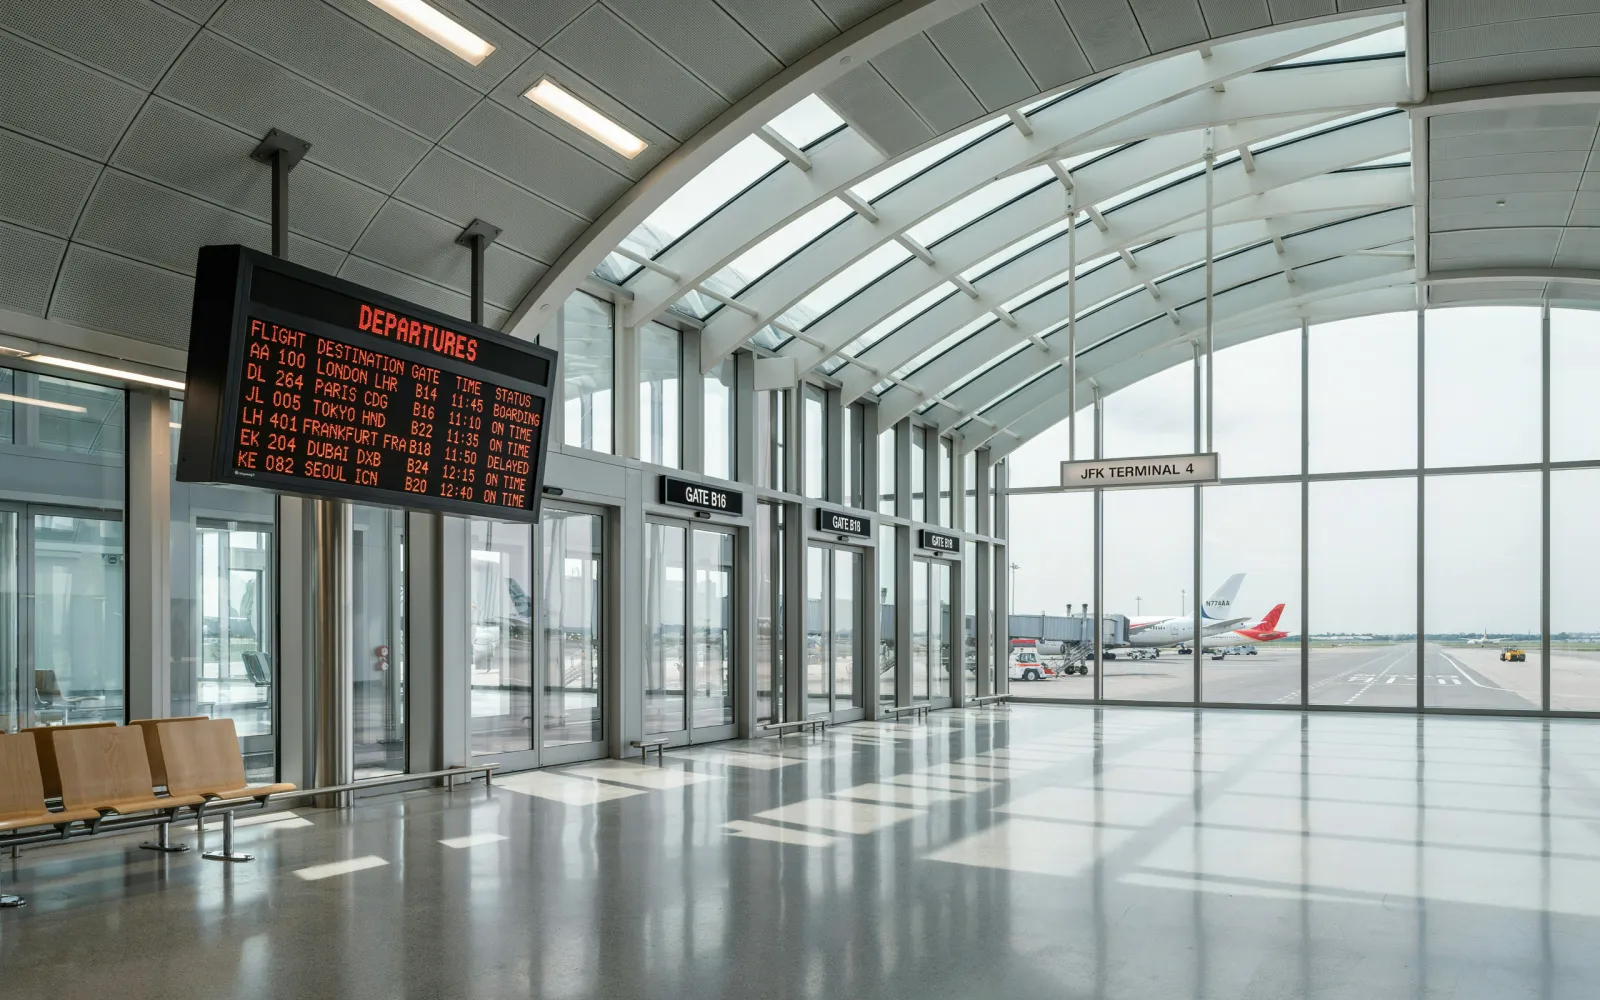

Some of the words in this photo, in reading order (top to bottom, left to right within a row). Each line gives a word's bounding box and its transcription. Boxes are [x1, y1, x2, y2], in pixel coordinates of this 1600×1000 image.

[251, 320, 307, 349] FLIGHT
[317, 338, 405, 375] DESTINATION
[411, 364, 440, 385] GATE
[456, 375, 482, 395] TIME
[496, 387, 531, 408] STATUS
[358, 304, 478, 362] DEPARTURES
[247, 362, 266, 383] DL
[275, 369, 304, 390] 264
[314, 378, 358, 402] PARIS
[363, 390, 389, 409] CDG
[413, 401, 435, 420] B16
[449, 412, 481, 431] 11:10
[491, 421, 505, 434] ON
[510, 424, 533, 442] TIME
[249, 342, 270, 360] AA
[279, 348, 306, 369] 100
[316, 358, 368, 384] LONDON
[374, 373, 399, 392] LHR
[415, 383, 438, 401] B14
[451, 393, 484, 413] 11:45
[493, 403, 540, 427] BOARDING
[242, 407, 263, 425] LH
[269, 413, 297, 433] 401
[302, 417, 379, 446] FRANKFURT
[383, 433, 407, 452] FRA
[408, 439, 431, 457] B18
[445, 446, 477, 465] 11:50
[487, 455, 529, 475] DELAYED
[245, 386, 264, 404] JL
[273, 390, 302, 411] 005
[313, 399, 356, 423] TOKYO
[361, 410, 386, 429] HND
[410, 419, 433, 439] B22
[447, 429, 479, 448] 11:35
[489, 438, 503, 452] ON
[507, 441, 531, 459] TIME
[237, 450, 258, 469] KE
[265, 454, 294, 474] 082
[304, 460, 346, 481] SEOUL
[355, 468, 379, 486] ICN
[404, 475, 427, 493] B20
[440, 482, 473, 500] 12:40
[483, 489, 497, 503] ON
[502, 492, 525, 508] TIME
[240, 427, 260, 447] EK
[267, 433, 297, 453] 204
[306, 439, 349, 462] DUBAI
[356, 448, 382, 468] DXB
[406, 457, 429, 475] B24
[442, 465, 476, 483] 12:15
[485, 472, 499, 486] ON
[503, 475, 526, 491] TIME
[1081, 468, 1104, 479] JFK
[1109, 464, 1180, 478] TERMINAL
[1186, 463, 1194, 474] 4
[686, 487, 709, 505] GATE
[711, 491, 726, 508] B16
[832, 515, 849, 530] GATE
[850, 519, 861, 532] B18
